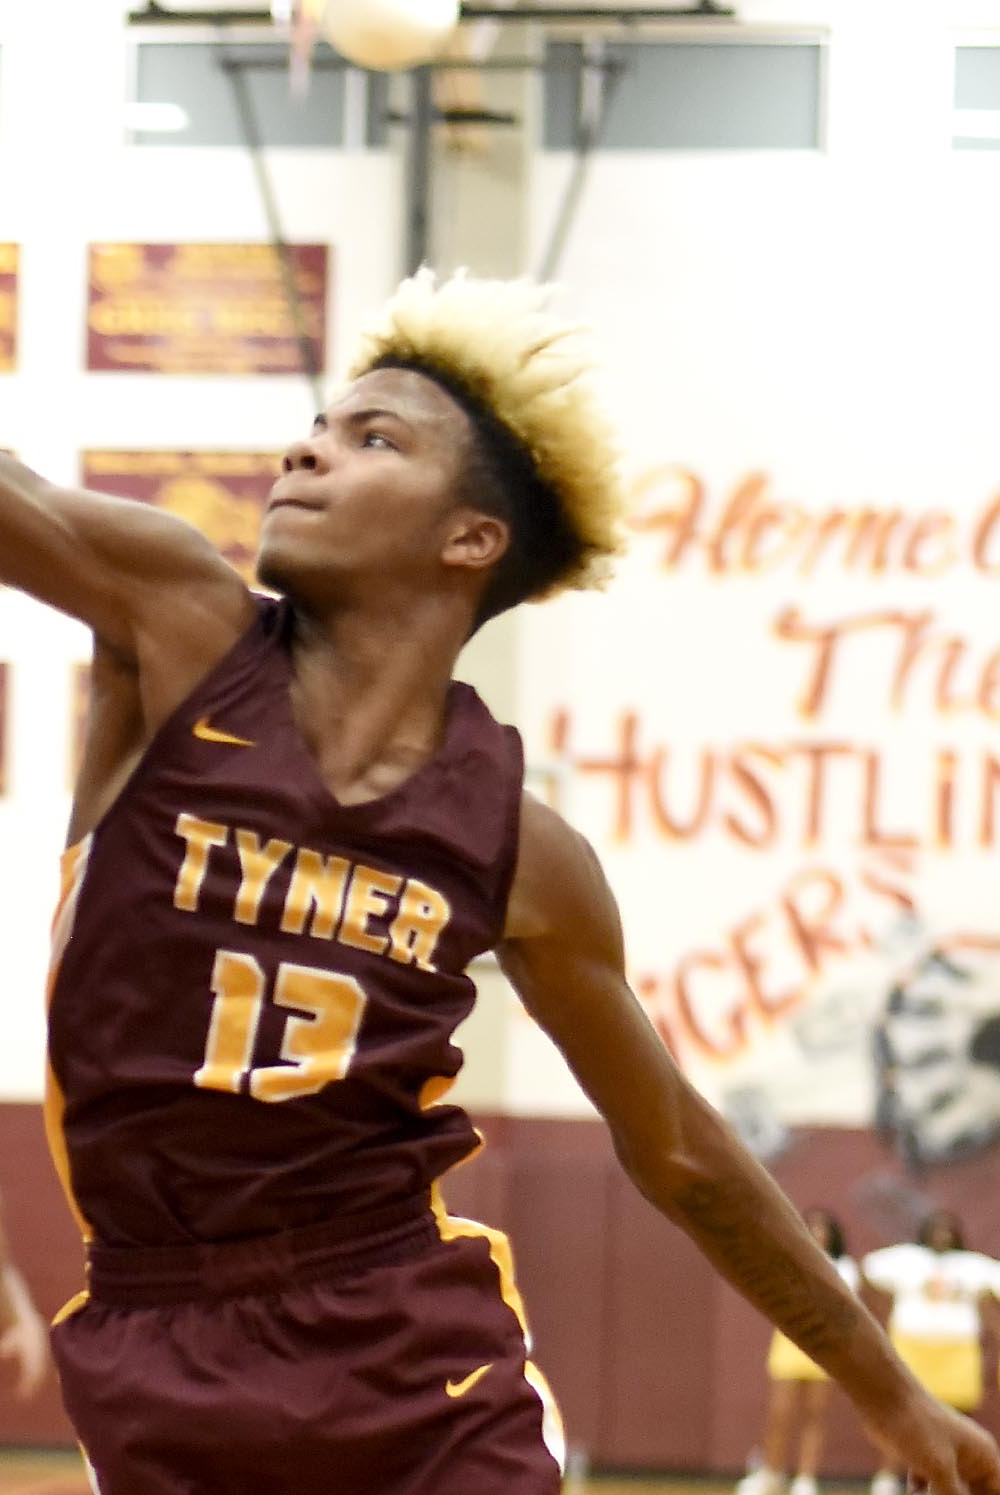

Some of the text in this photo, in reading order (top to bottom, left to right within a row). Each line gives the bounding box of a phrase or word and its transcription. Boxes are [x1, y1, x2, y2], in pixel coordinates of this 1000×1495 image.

[626, 465, 960, 576] Home
[172, 812, 451, 973] TYNER
[194, 949, 366, 1103] 13
